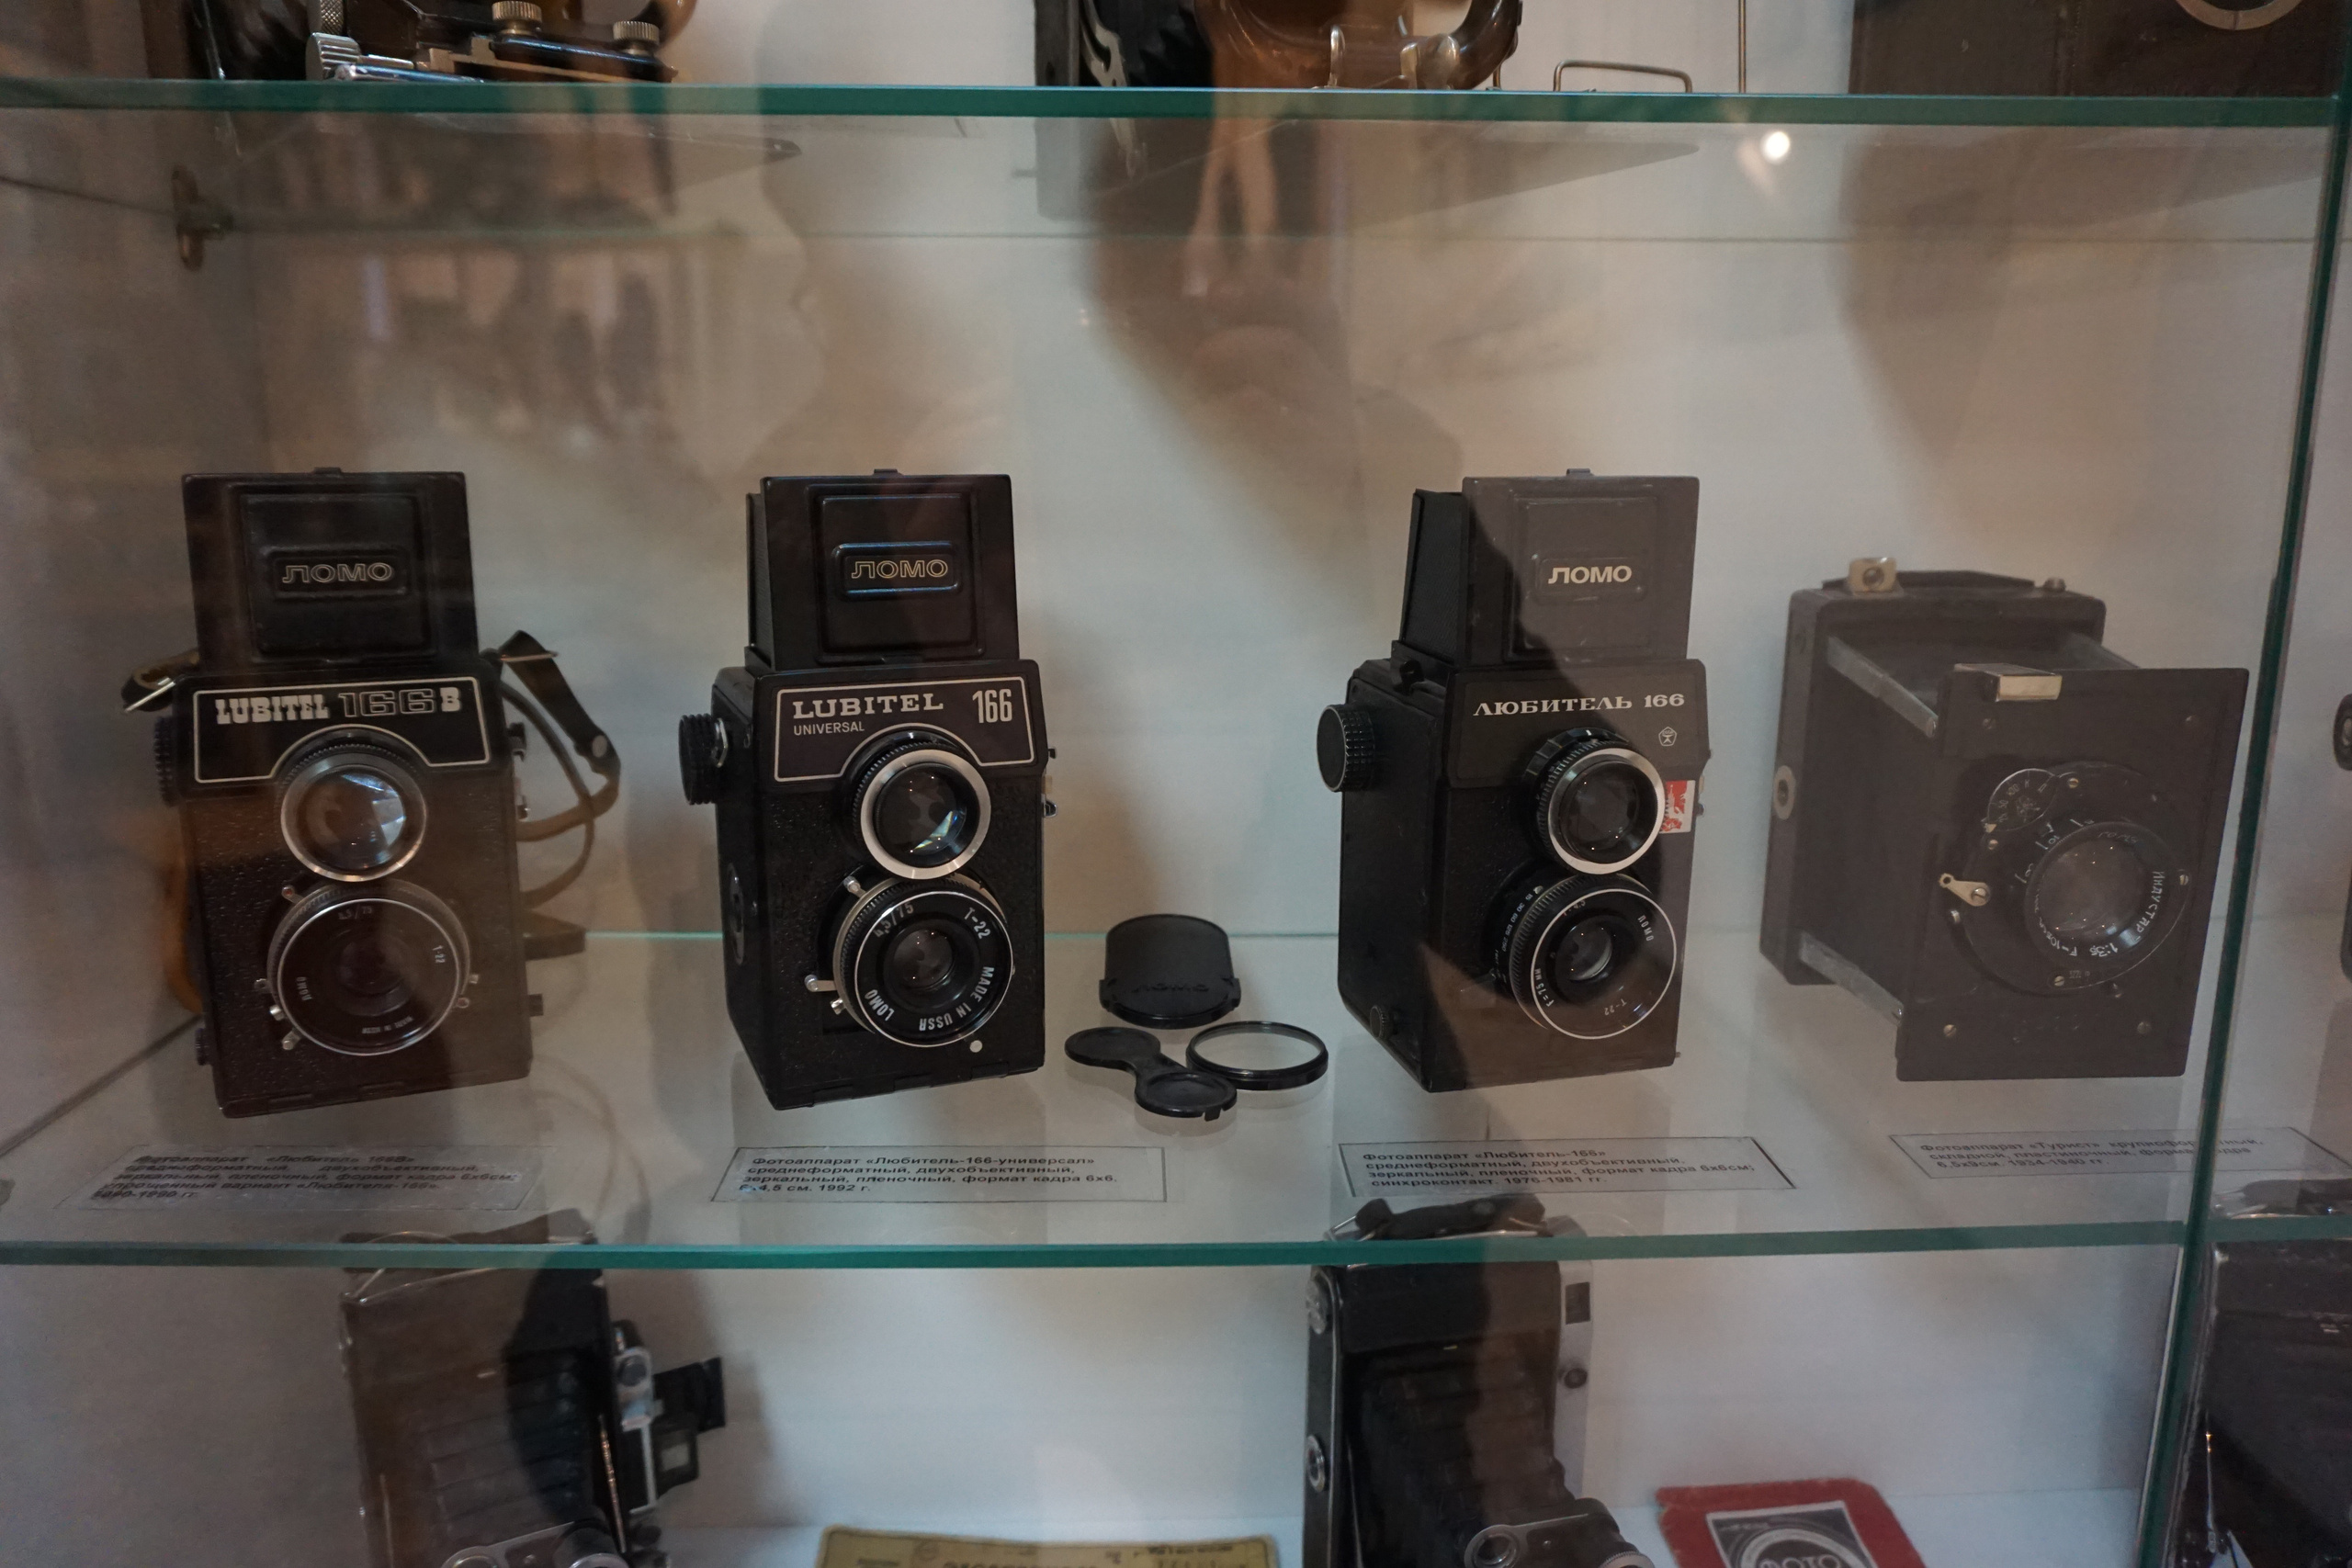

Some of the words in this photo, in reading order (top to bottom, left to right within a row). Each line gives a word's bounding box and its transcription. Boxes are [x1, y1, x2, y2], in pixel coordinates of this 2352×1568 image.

[282, 562, 395, 583] ЛОМО
[851, 559, 948, 579] ЛОМО
[1548, 565, 1633, 584] ЛОМО
[215, 694, 331, 725] LUBITEL
[792, 693, 944, 719] LUBITEL
[972, 688, 1012, 723] 166
[1473, 696, 1633, 716] ЛЮБИТЕЛЬ
[1644, 694, 1685, 707] 166
[793, 721, 865, 736] UNIVERSAL
[970, 965, 995, 1003] MADE
[864, 988, 895, 1021] LOMO
[956, 1002, 972, 1019] IN
[919, 1012, 953, 1032] USSR
[1363, 1152, 1469, 1160] Фотоаппарат
[1475, 1150, 1606, 1159] «Любитель-166»
[1920, 1144, 2024, 1152] Фотоаппарат
[747, 1166, 910, 1175] среднеформатный,
[916, 1166, 1075, 1175] двухобъективный,
[1366, 1159, 1526, 1170] среднеформатный,
[1368, 1169, 1474, 1179] зеркальный,
[1479, 1168, 1577, 1177] пленочный,
[1581, 1167, 1645, 1177] формат
[1650, 1166, 1697, 1174] кадра
[335, 1173, 402, 1182] формат
[407, 1174, 456, 1182] кадра
[742, 1175, 850, 1183] зеркальный,
[855, 1175, 956, 1183] пленочный,
[961, 1175, 1027, 1183] формат
[1033, 1175, 1080, 1183] кадра
[1372, 1178, 1498, 1187] синхроконтакт.
[1504, 1176, 1582, 1185] 1976-1981
